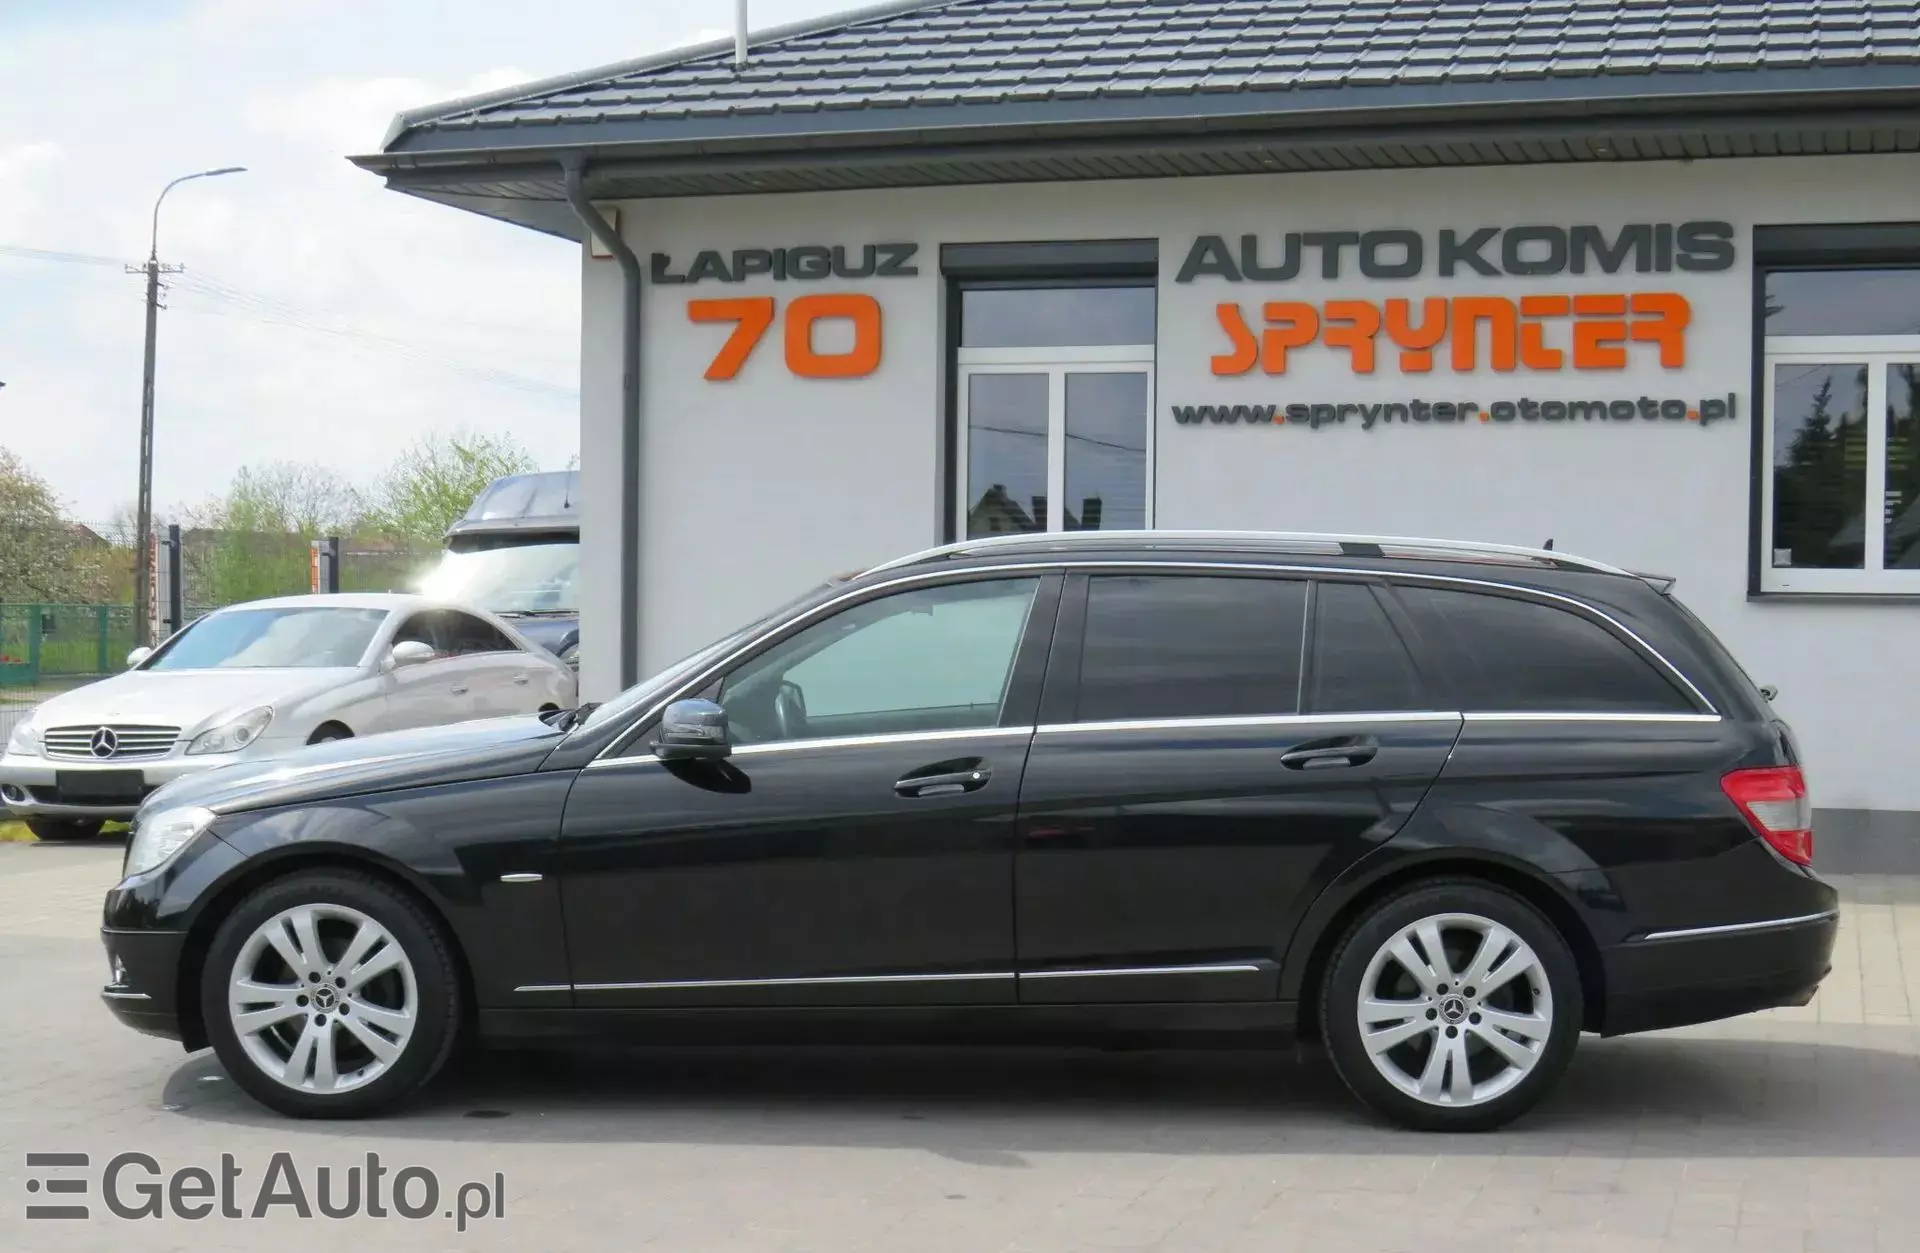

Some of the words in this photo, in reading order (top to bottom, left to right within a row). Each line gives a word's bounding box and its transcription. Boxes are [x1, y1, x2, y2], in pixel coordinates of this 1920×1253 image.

[651, 243, 919, 284] ŁAPIGUZ
[1175, 228, 1423, 283] AUTO
[1438, 220, 1736, 277] KOMIS
[687, 293, 882, 381] 70
[1210, 292, 1692, 376] SPRYNTER
[1171, 392, 1737, 431] www.sprynter.otomoto.pl
